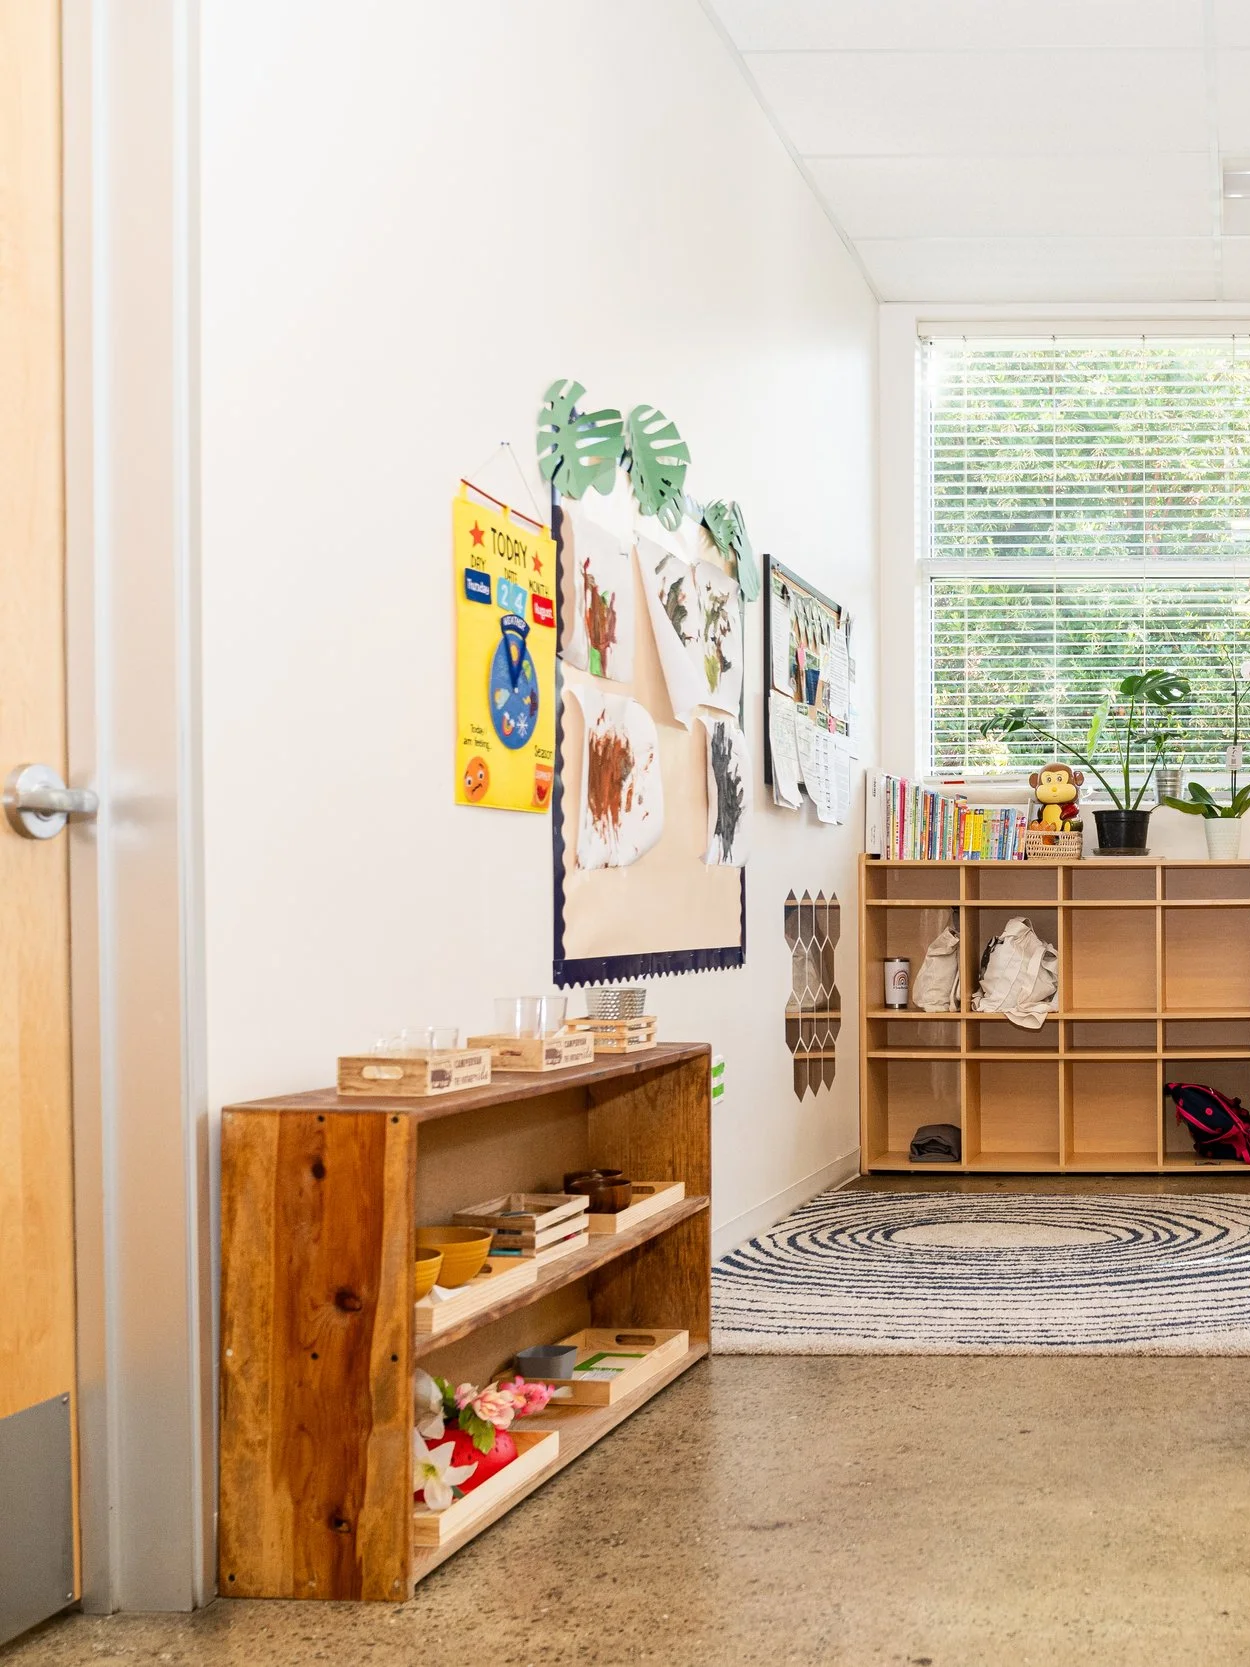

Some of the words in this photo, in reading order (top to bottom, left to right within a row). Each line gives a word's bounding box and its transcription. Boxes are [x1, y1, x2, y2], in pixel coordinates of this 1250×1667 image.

[491, 527, 527, 569] TODAY
[471, 554, 486, 571] DAY
[529, 580, 548, 597] MONTH
[534, 603, 553, 621] August
[502, 616, 527, 631] WEATHER
